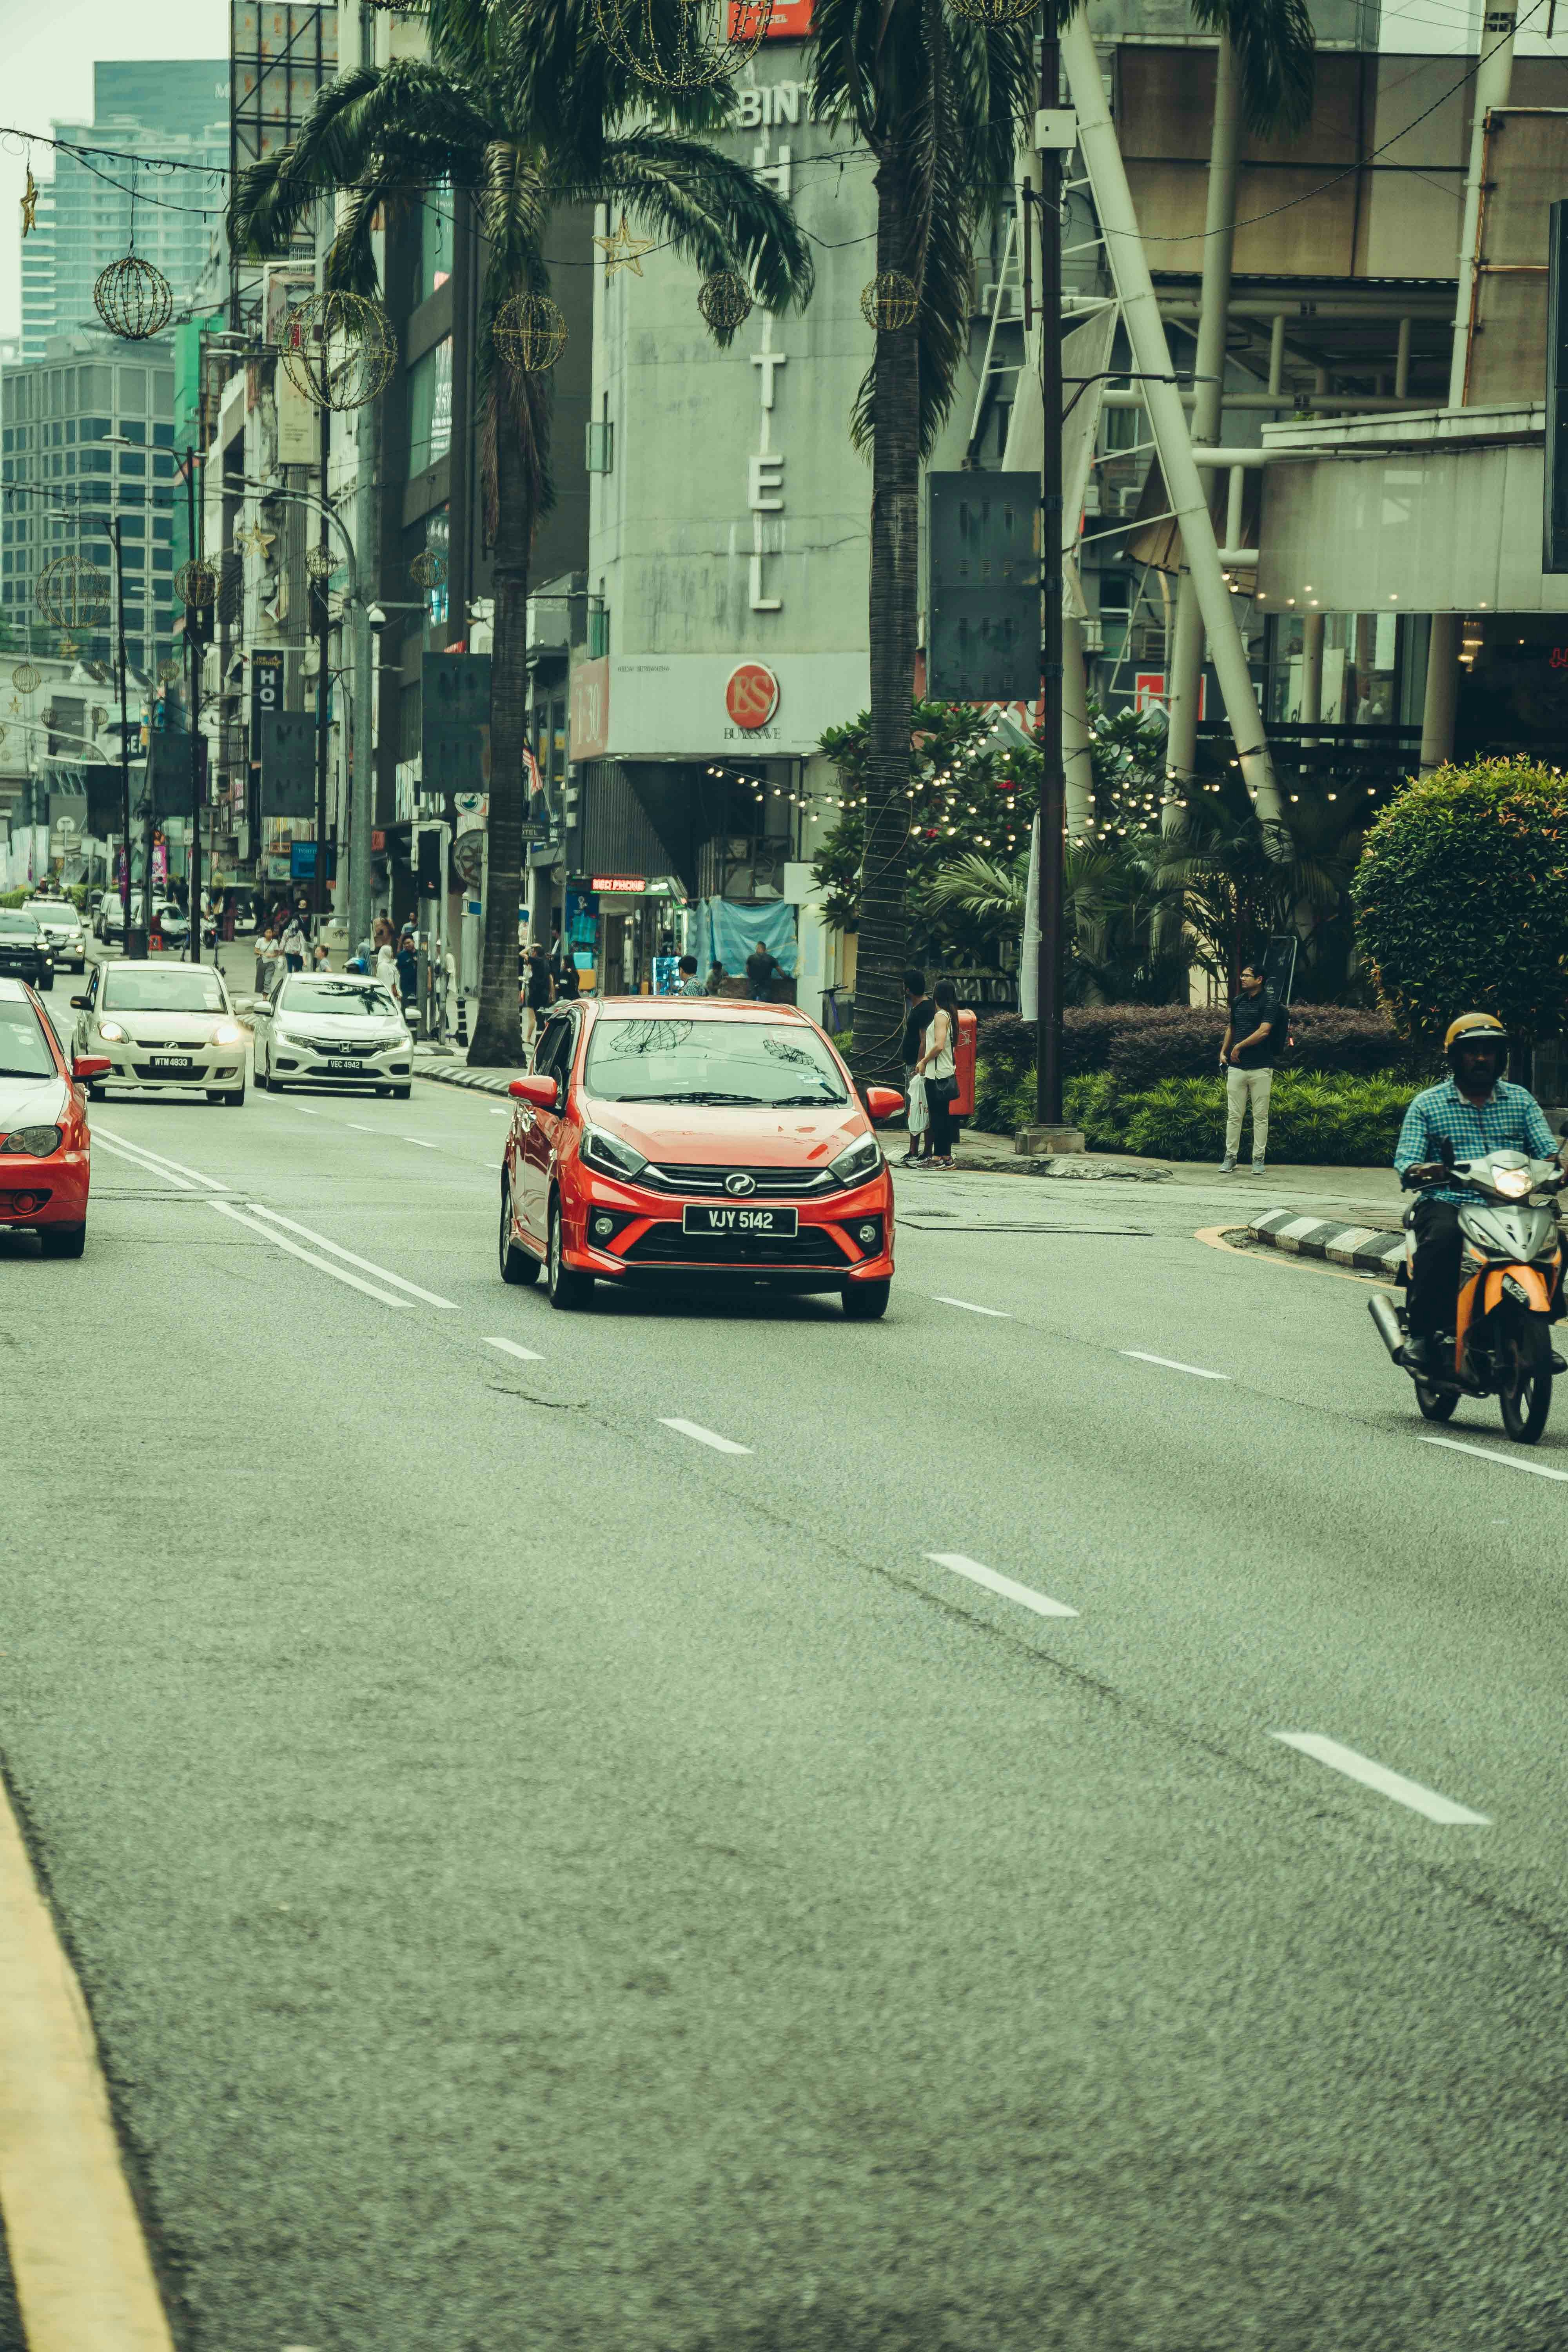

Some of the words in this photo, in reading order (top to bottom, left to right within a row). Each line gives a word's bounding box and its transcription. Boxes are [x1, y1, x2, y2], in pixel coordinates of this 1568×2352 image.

[748, 145, 791, 610] HTEL
[155, 1057, 169, 1066] WTM
[343, 1061, 359, 1069] 4942
[709, 1210, 736, 1227] VJY
[739, 1212, 773, 1229] 5142
